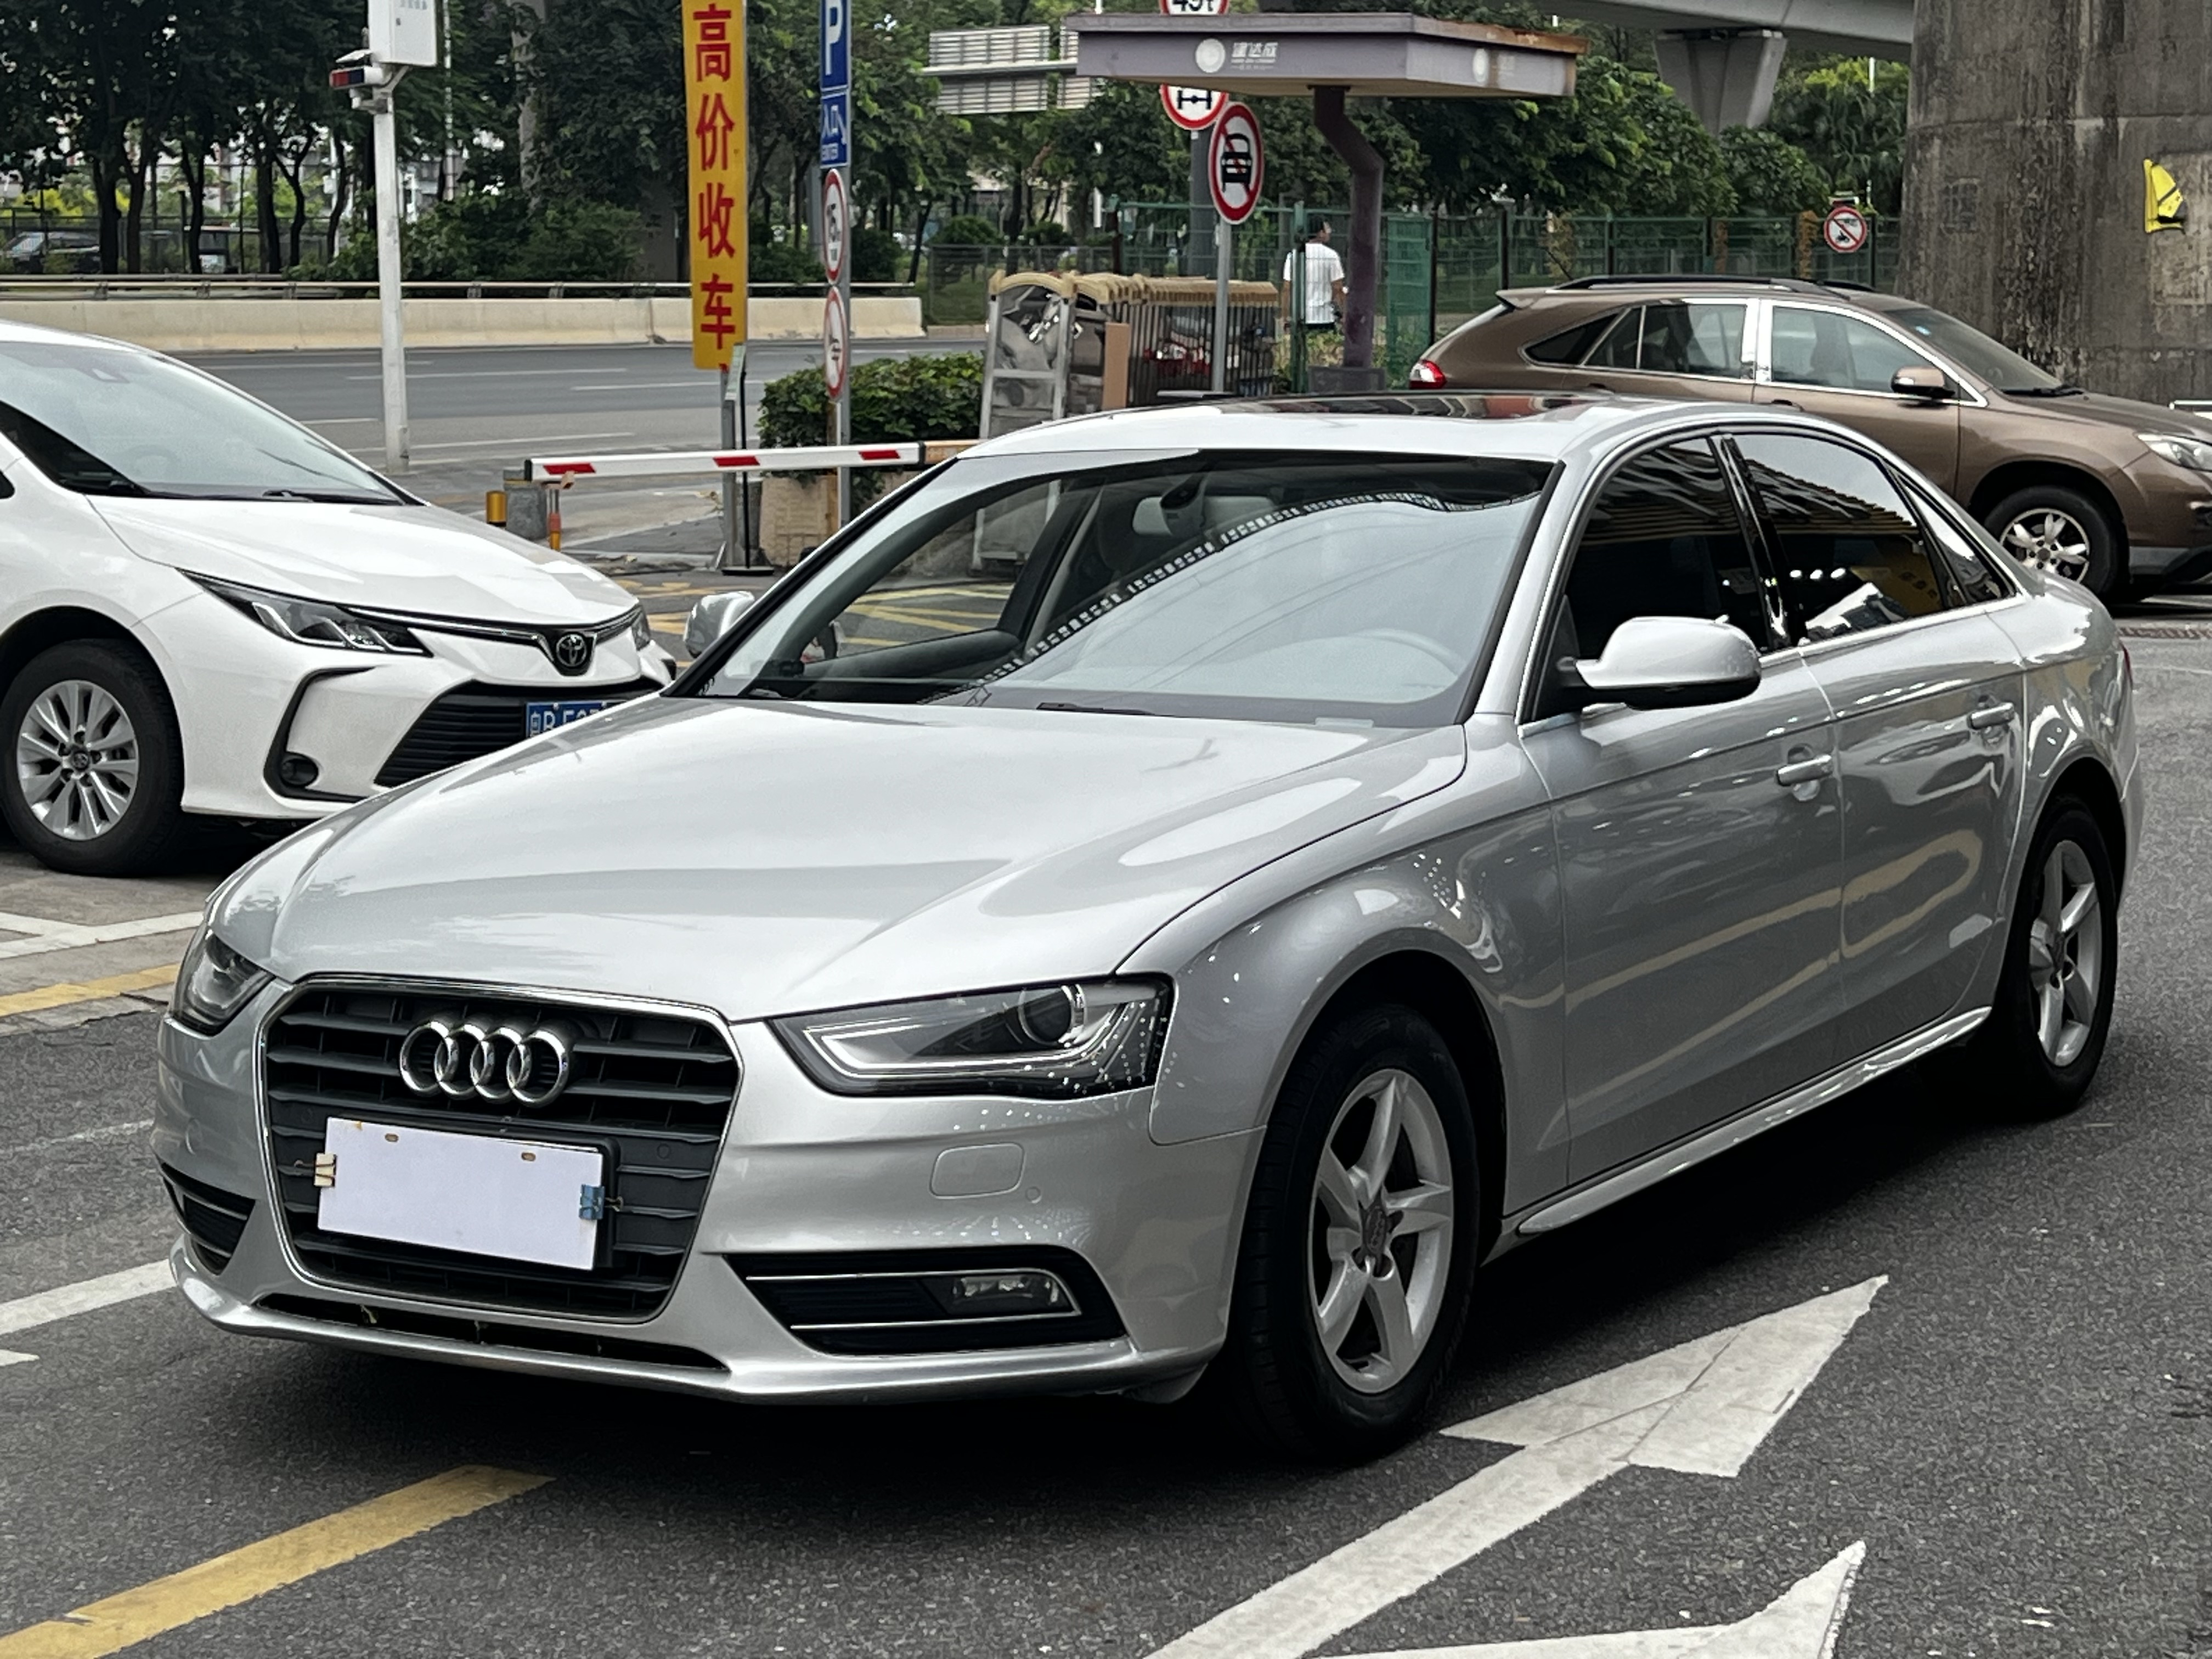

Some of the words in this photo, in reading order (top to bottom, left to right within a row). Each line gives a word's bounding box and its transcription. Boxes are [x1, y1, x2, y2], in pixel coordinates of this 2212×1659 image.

[825, 0, 843, 76] P
[693, 3, 736, 350] 高价收车
